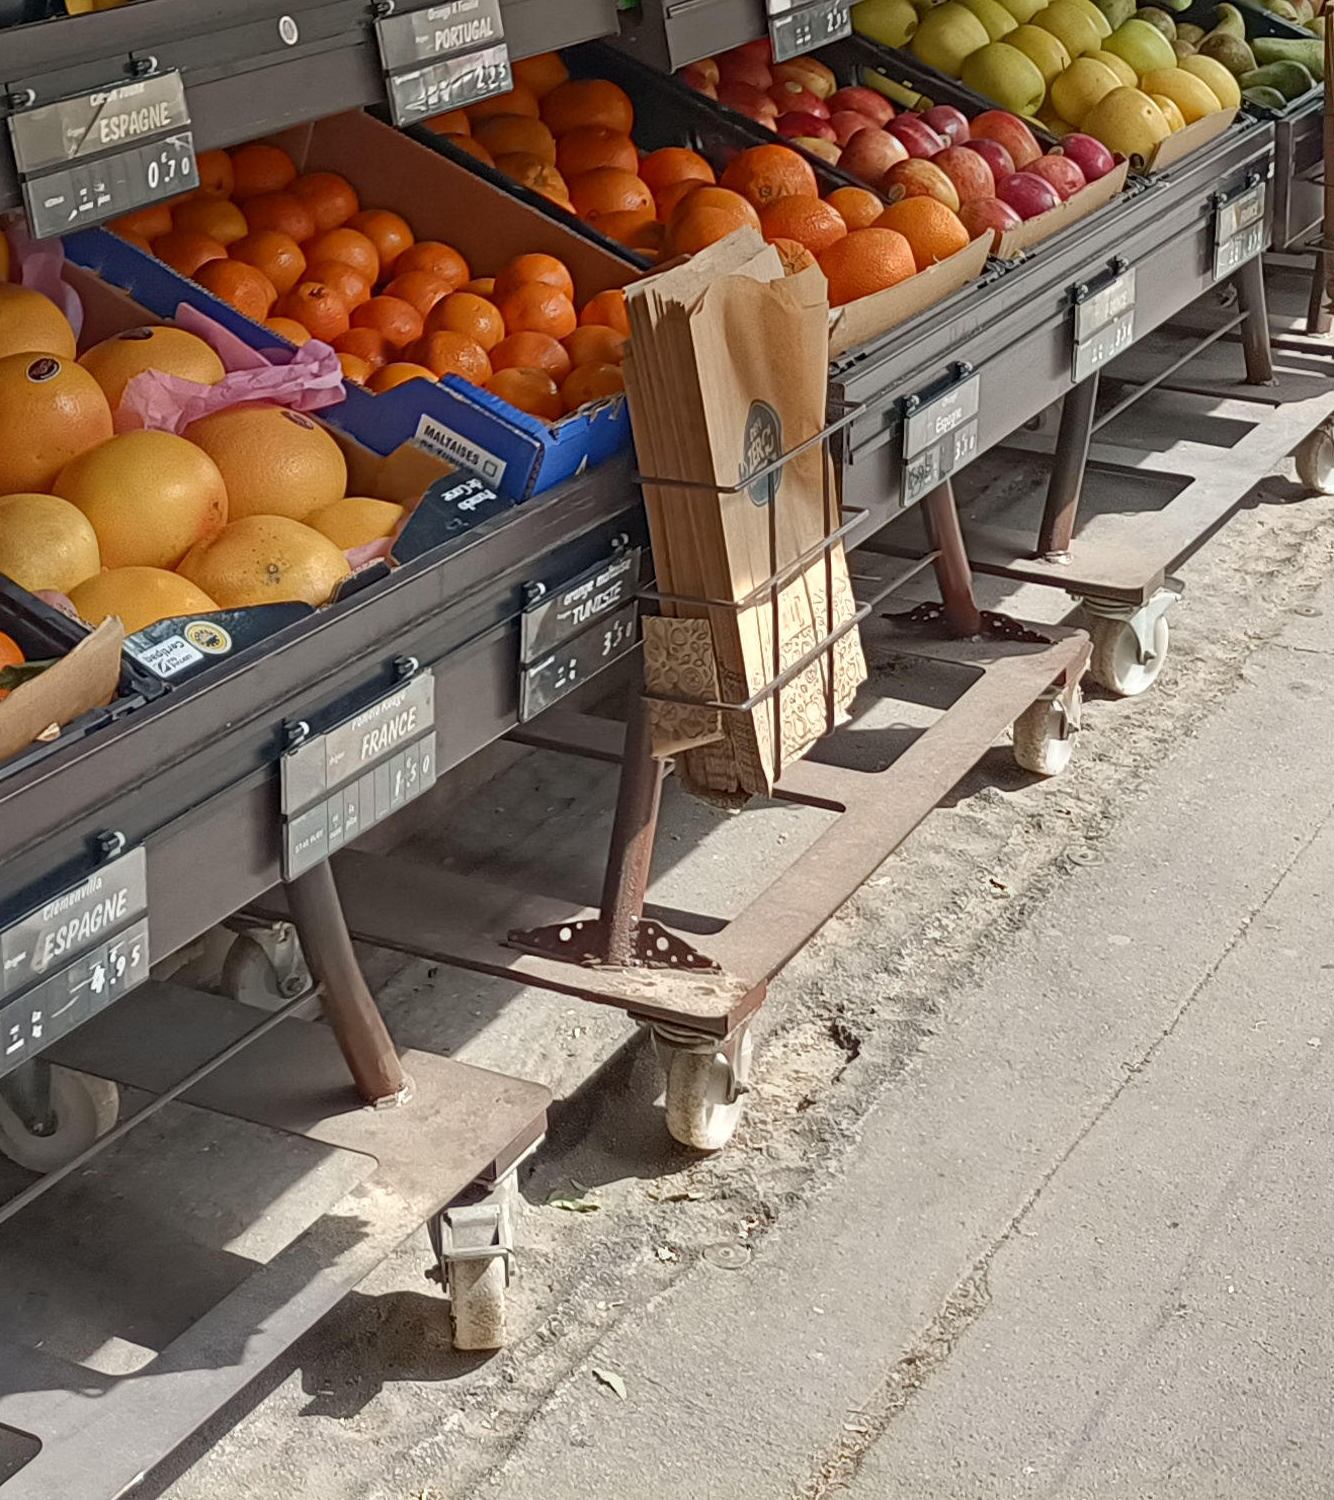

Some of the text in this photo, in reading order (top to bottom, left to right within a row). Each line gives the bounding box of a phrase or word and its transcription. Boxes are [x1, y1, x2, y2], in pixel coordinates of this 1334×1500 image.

[435, 16, 494, 52] PORTUGAL
[100, 101, 171, 143] ESPAGNE
[424, 425, 480, 466] MALTAISES
[142, 640, 185, 663] Certipaq
[361, 705, 417, 761] FRANCE
[43, 887, 129, 962] ESPAGNE
